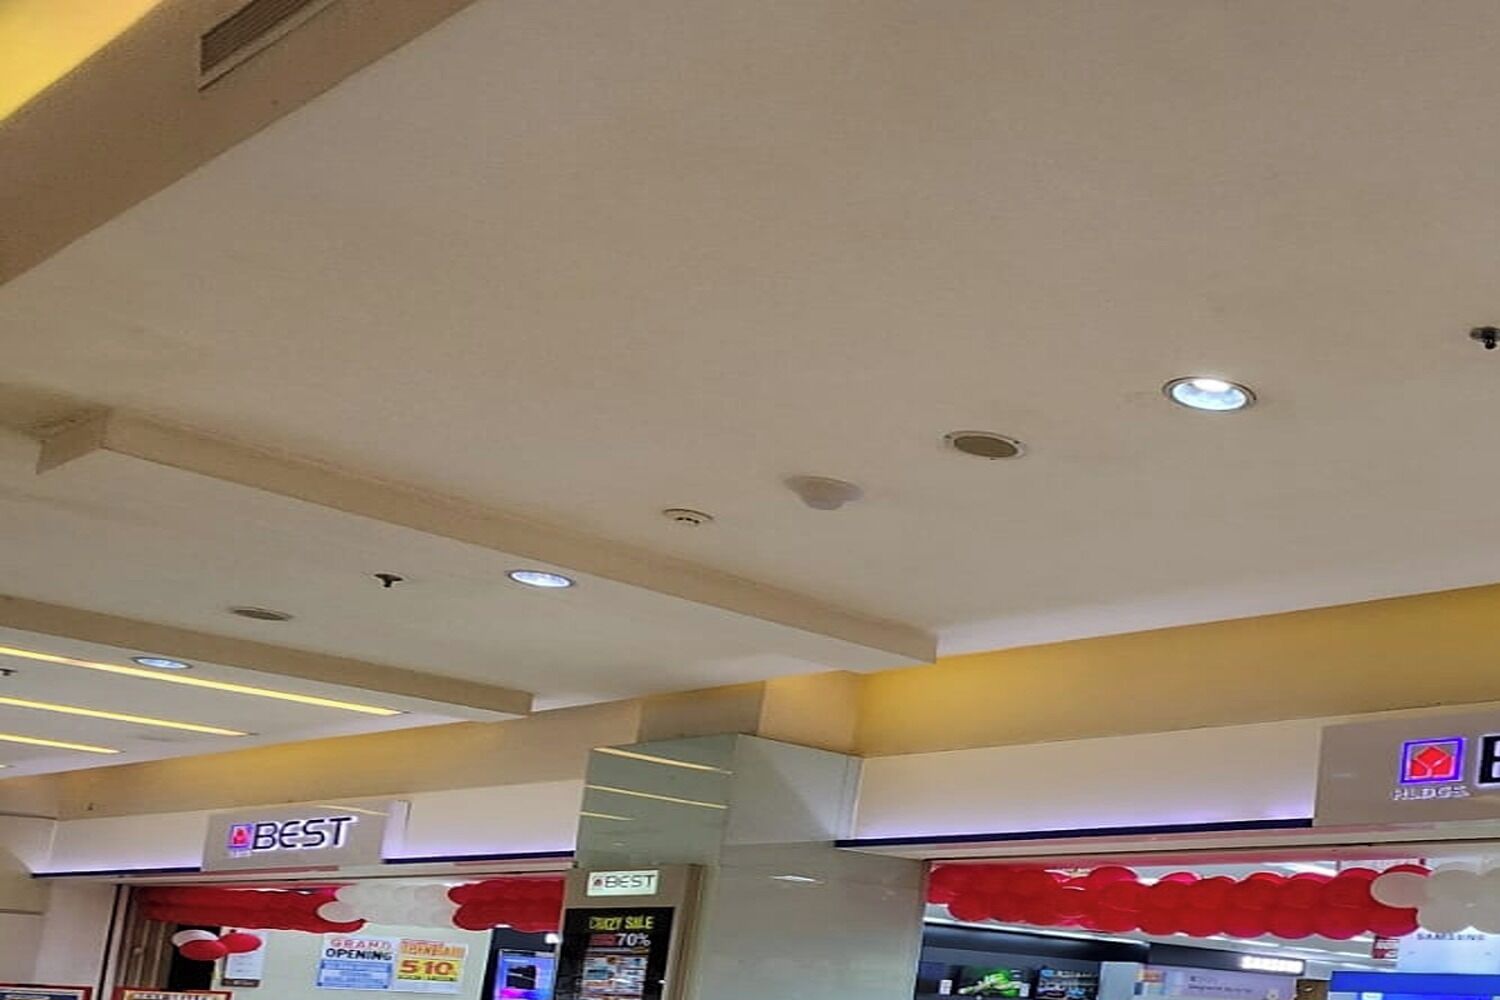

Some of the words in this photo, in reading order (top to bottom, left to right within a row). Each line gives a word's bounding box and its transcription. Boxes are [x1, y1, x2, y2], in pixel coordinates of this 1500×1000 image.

[251, 816, 353, 851] BEST
[605, 874, 656, 889] BEST
[624, 914, 655, 930] SALE
[615, 932, 652, 947] 70%
[325, 947, 393, 961] OPENING
